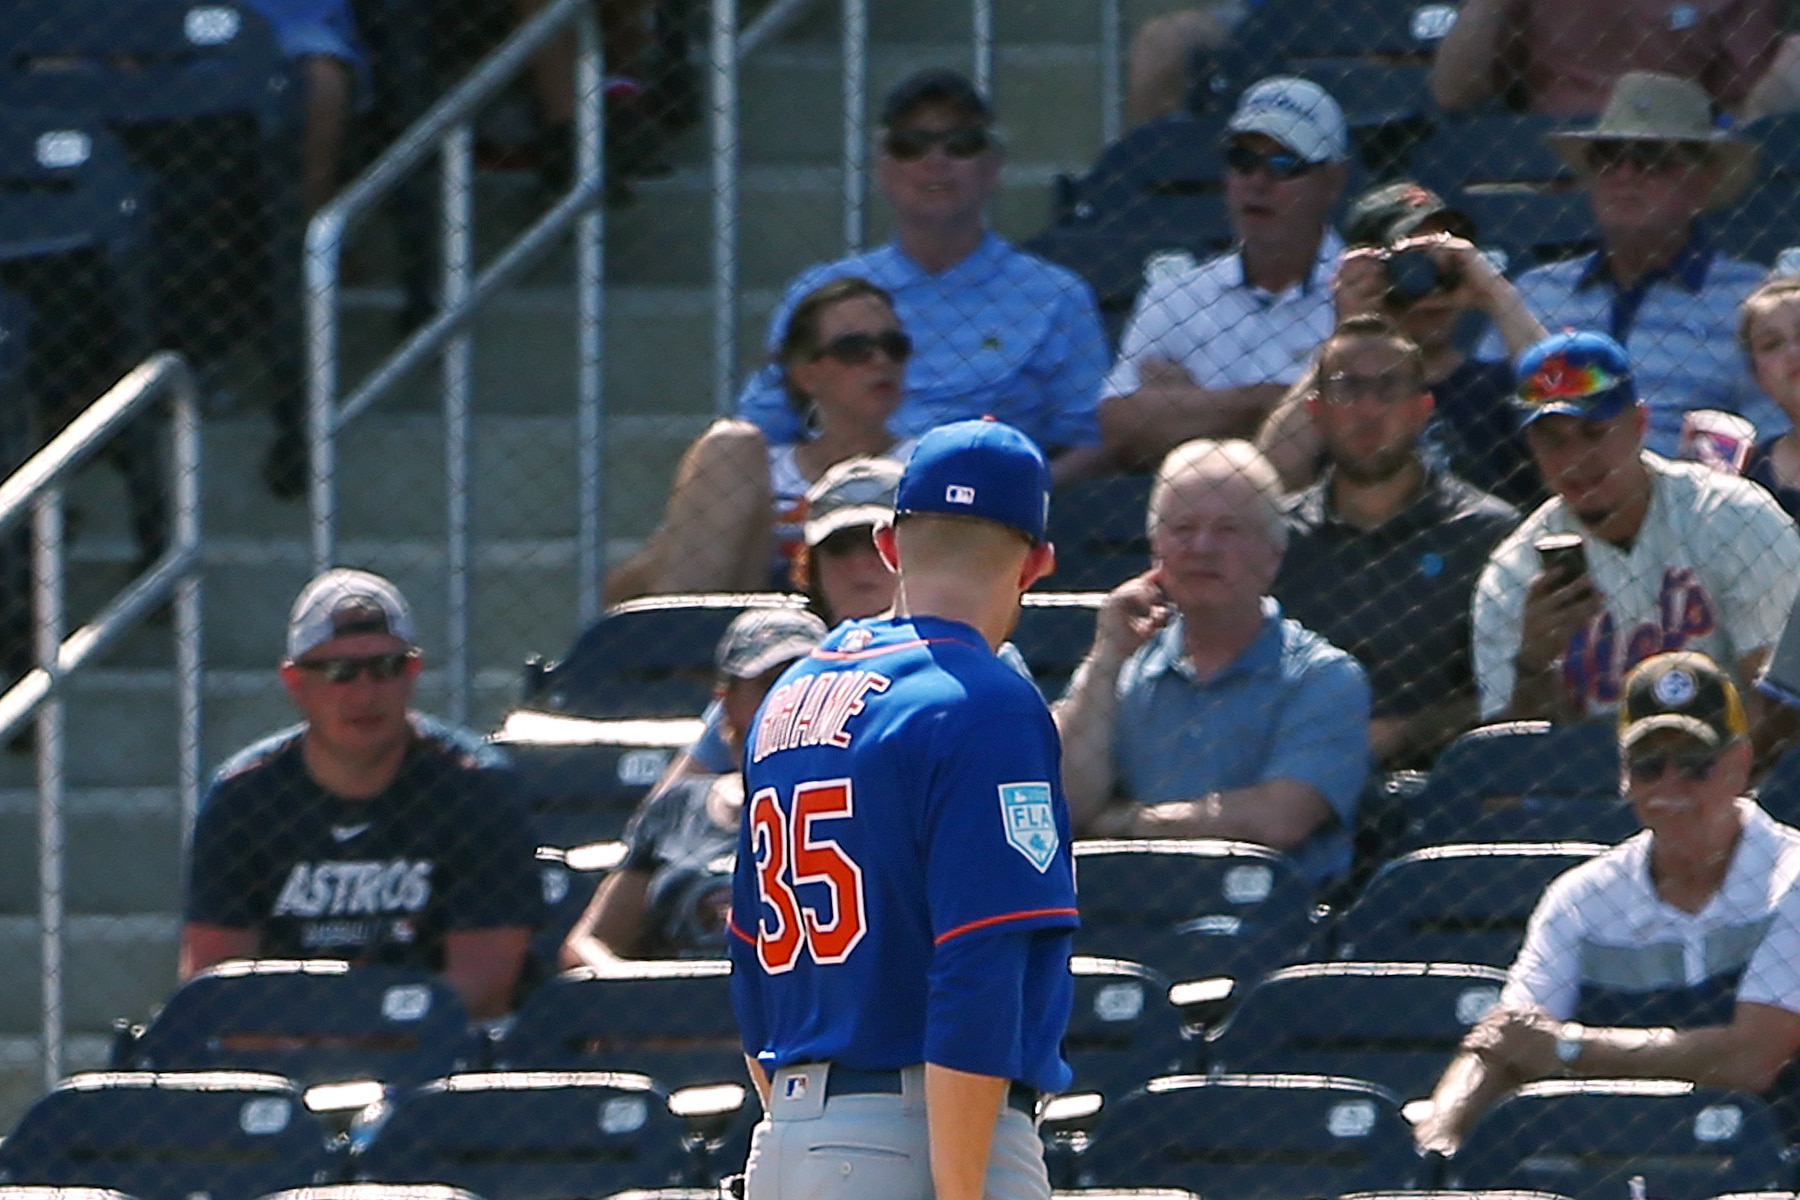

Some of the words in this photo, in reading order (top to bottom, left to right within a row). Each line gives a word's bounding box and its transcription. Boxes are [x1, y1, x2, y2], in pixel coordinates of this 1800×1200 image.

[1013, 806, 1051, 828] FLA
[271, 860, 434, 918] ASTROS
[750, 777, 868, 975] 35
